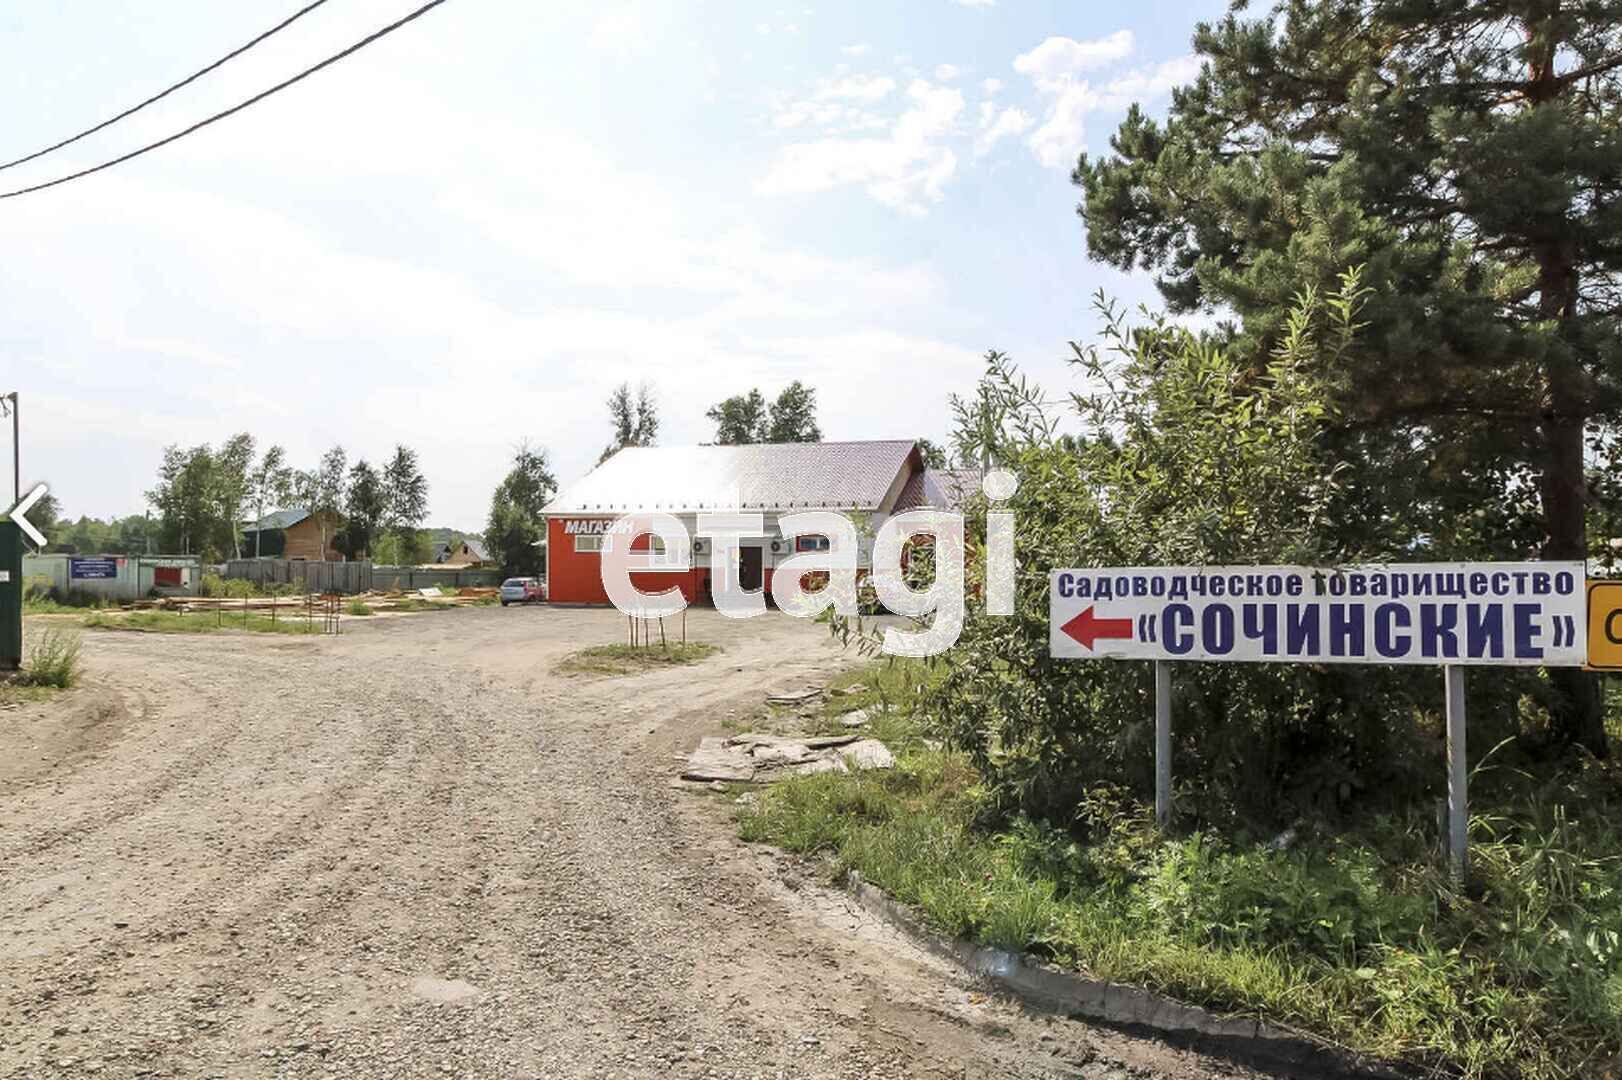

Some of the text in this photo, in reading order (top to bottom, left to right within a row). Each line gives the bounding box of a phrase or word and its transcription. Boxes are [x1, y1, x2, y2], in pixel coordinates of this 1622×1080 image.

[564, 520, 633, 535] МАГАЗИН
[1058, 571, 1575, 600] Садоводческое товарищество
[1138, 602, 1576, 659] «СОЧИНСКИЕ»
